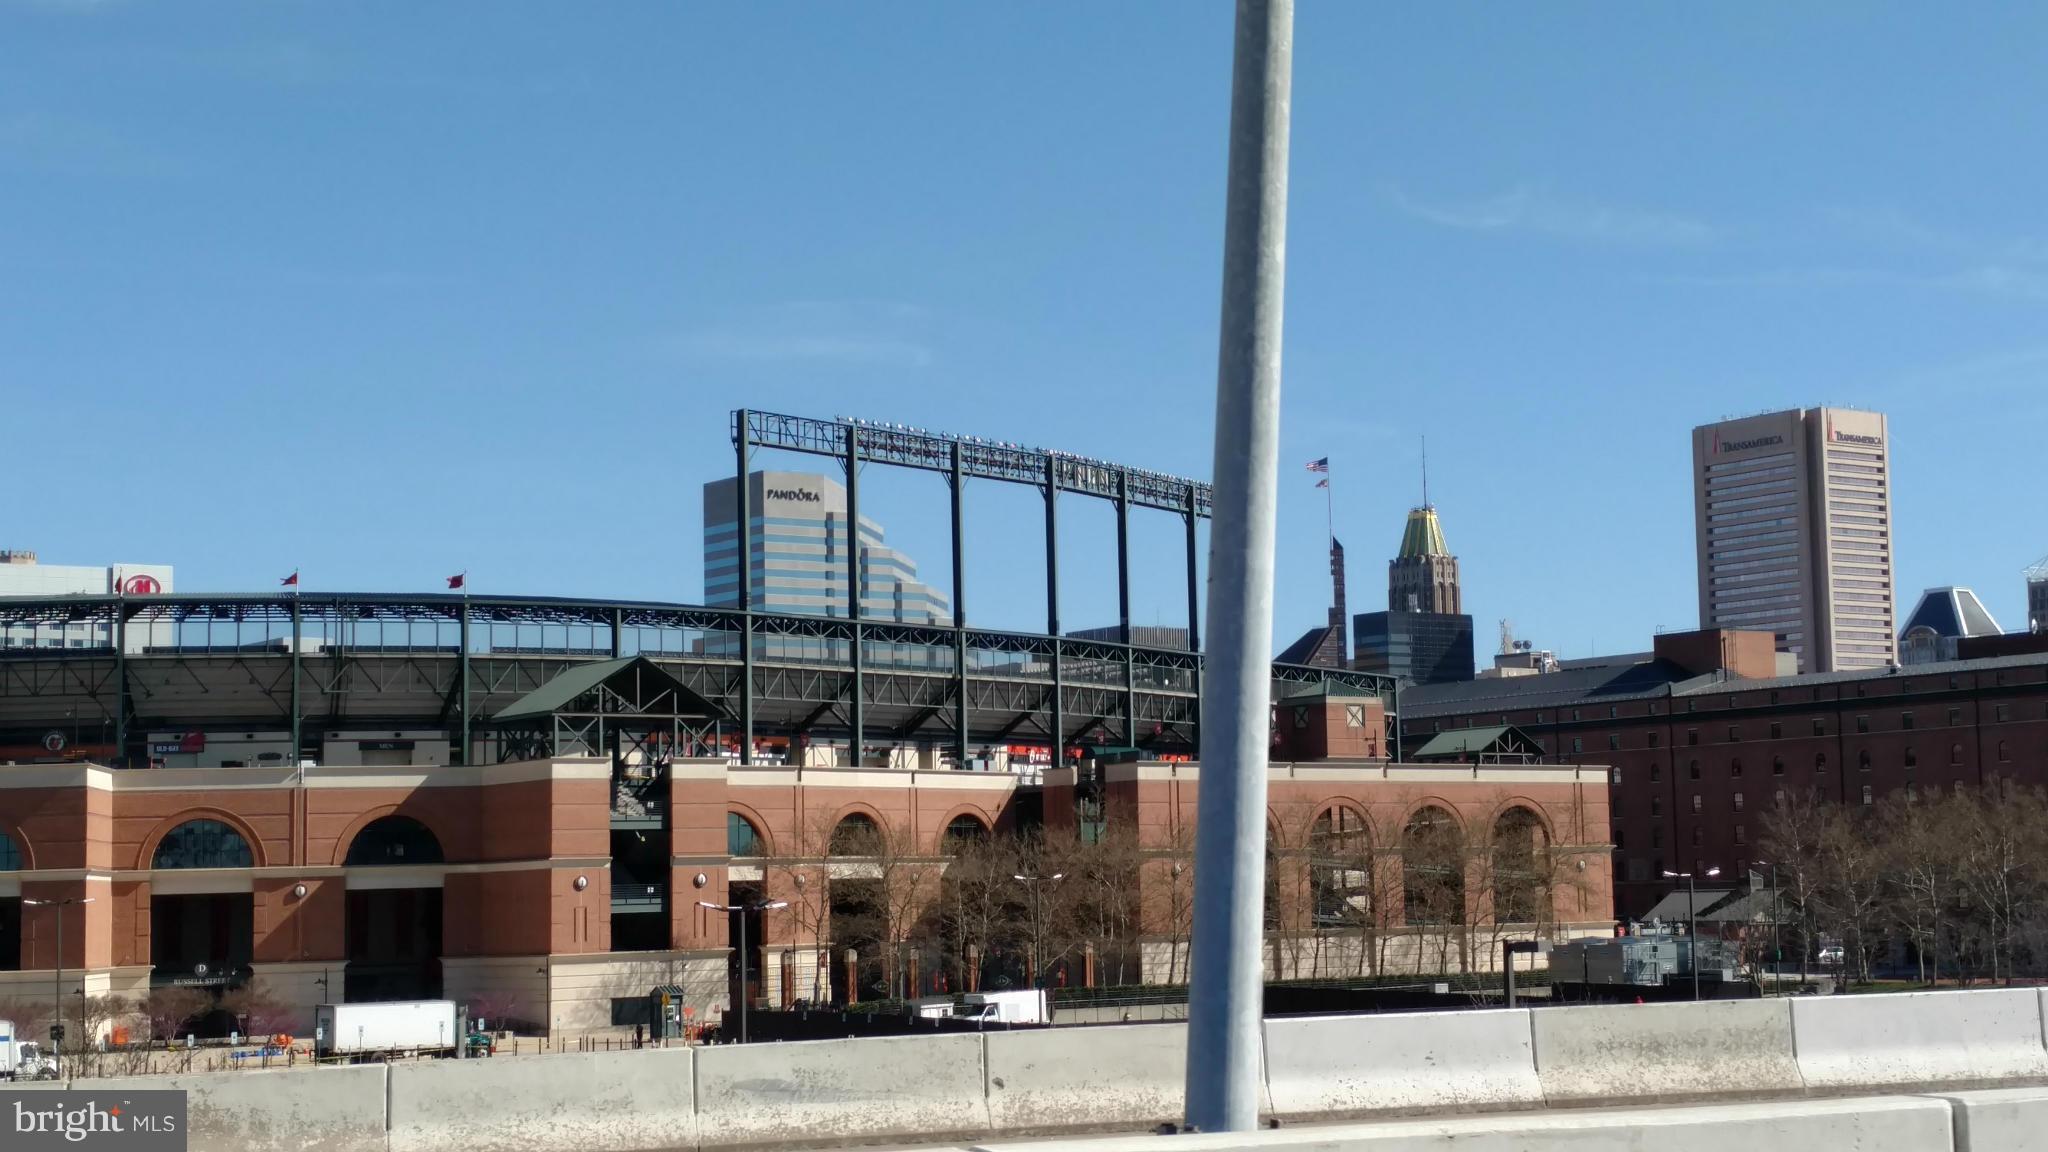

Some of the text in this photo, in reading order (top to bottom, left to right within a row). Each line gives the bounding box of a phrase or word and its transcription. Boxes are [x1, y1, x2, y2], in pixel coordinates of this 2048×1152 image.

[1722, 435, 1784, 452] TRANSAMERICA
[1834, 430, 1883, 445] TRANSAMERICA
[767, 488, 820, 502] PANDORA
